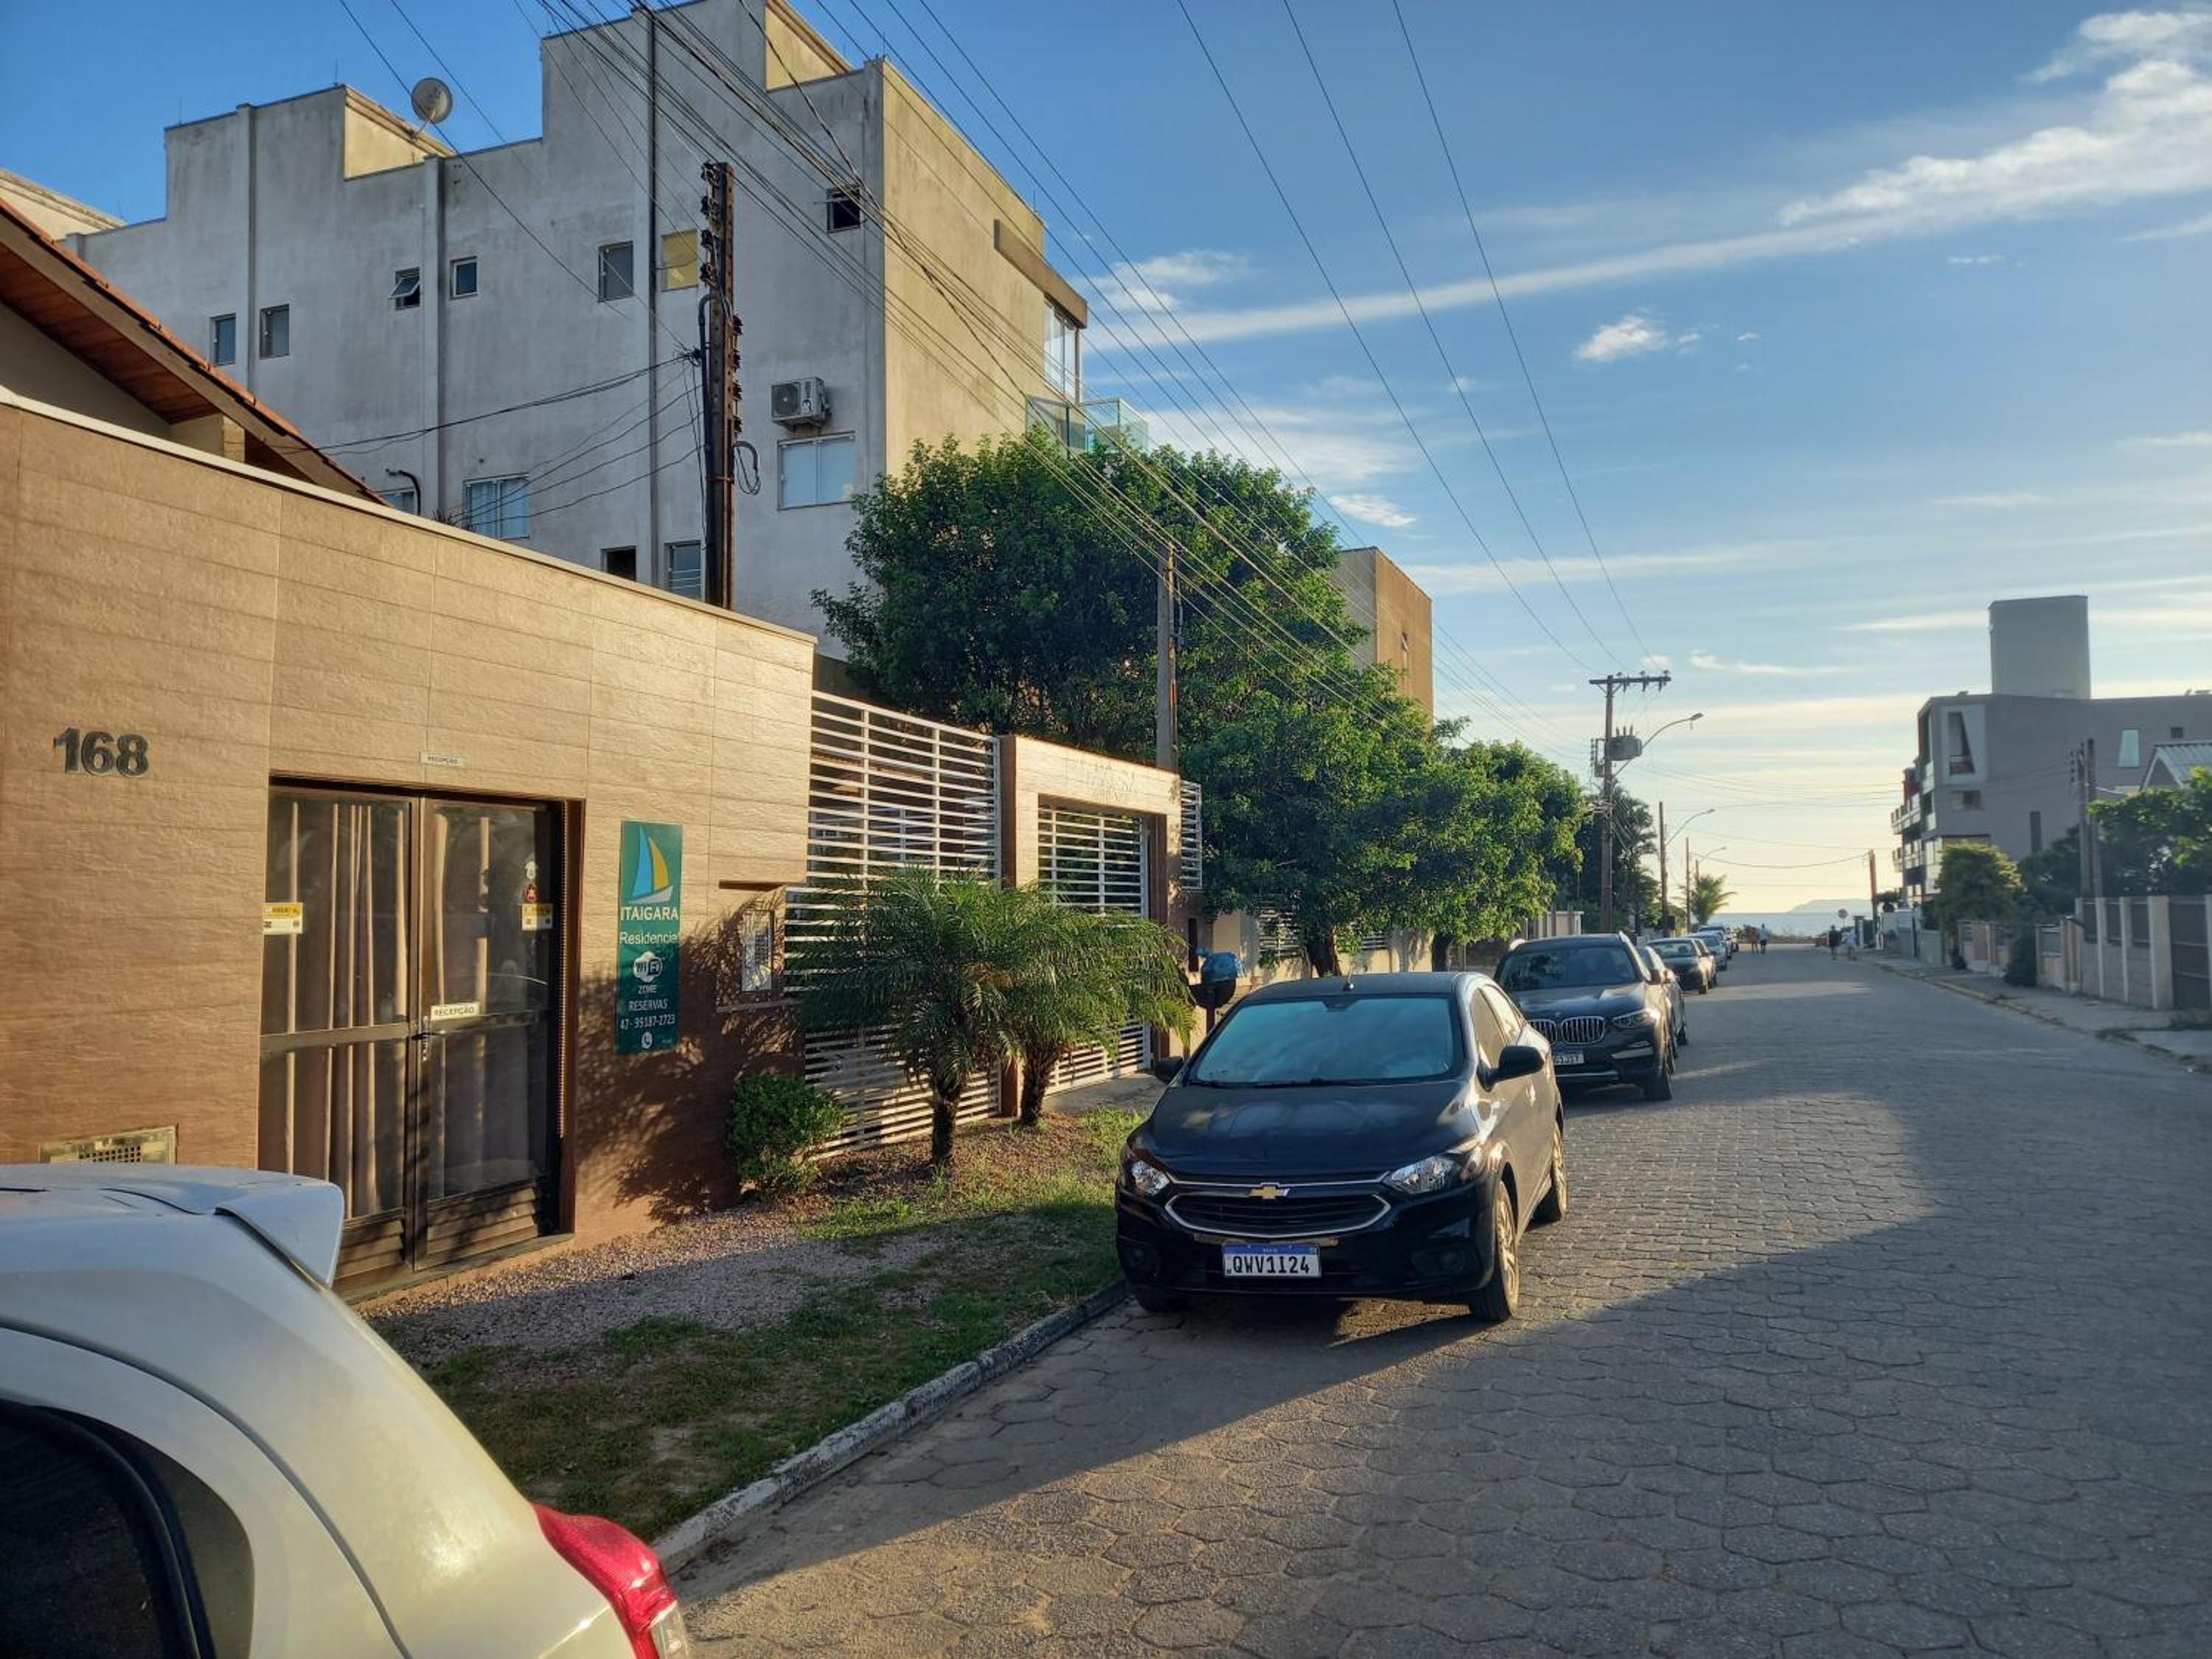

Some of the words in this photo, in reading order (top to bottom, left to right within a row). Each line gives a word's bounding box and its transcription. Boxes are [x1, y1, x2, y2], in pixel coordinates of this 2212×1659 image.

[53, 727, 149, 778] 168
[620, 906, 679, 921] ITAIGARA
[628, 998, 668, 1011] RESERVAS
